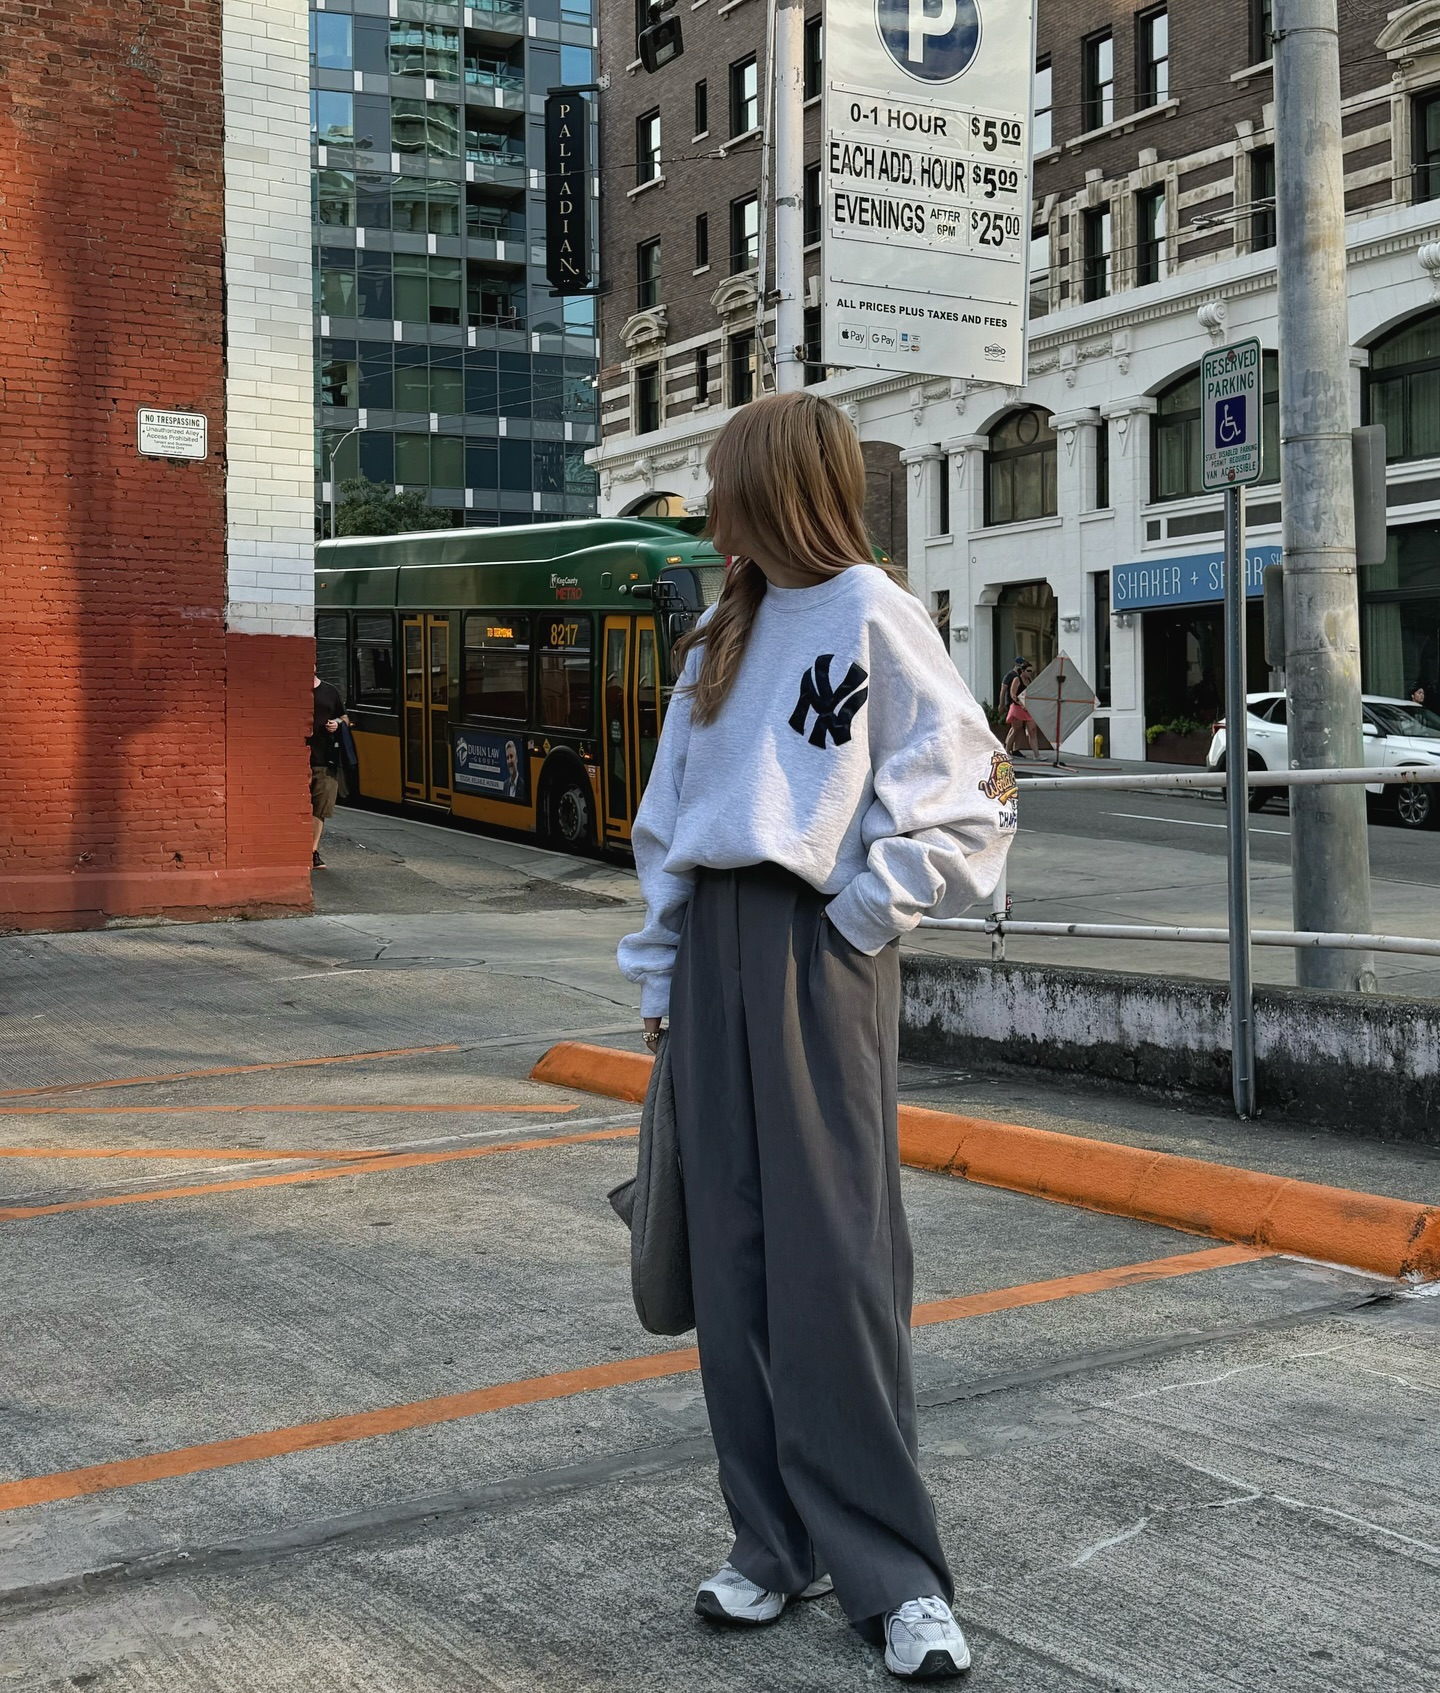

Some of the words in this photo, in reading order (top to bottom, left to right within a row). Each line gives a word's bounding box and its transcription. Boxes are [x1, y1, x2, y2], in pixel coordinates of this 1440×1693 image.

[908, 0, 957, 63] P
[850, 103, 879, 126] 0-1
[887, 108, 947, 136] HOUR
[829, 142, 875, 180] EACH
[878, 150, 916, 186] ADD.
[921, 155, 966, 194] HOUR
[559, 104, 579, 275] PALLADIAN
[834, 193, 925, 234] EVENINGS
[930, 209, 961, 224] AFTER
[937, 224, 956, 237] 6PM
[837, 298, 856, 309] ALL
[859, 301, 896, 314] PRICES
[899, 306, 925, 317] PLUS
[927, 310, 959, 322] TAXES
[961, 314, 982, 325] AND
[984, 317, 1008, 328] FEES
[850, 330, 865, 344] Pay
[871, 334, 880, 344] G
[881, 335, 896, 347] Pay
[1205, 348, 1257, 379] RESERVED
[1208, 371, 1254, 400] PARKING
[145, 414, 155, 423] NO
[157, 416, 200, 427] TRESPASSING
[146, 426, 184, 435] Unauthorized
[169, 435, 199, 443] Prohibited
[1205, 452, 1217, 461] STATE
[1219, 448, 1239, 458] DISABLED
[1240, 444, 1258, 452] PARKING
[1211, 458, 1227, 468] PERMIT
[1229, 453, 1251, 463] REQUIRED
[1206, 470, 1218, 480] VAN
[1117, 566, 1181, 600] SHAKER
[556, 587, 582, 600] METRO
[550, 623, 579, 646] 8217
[788, 653, 869, 750] NY
[468, 744, 487, 757] DUBIN
[487, 747, 500, 759] LAW
